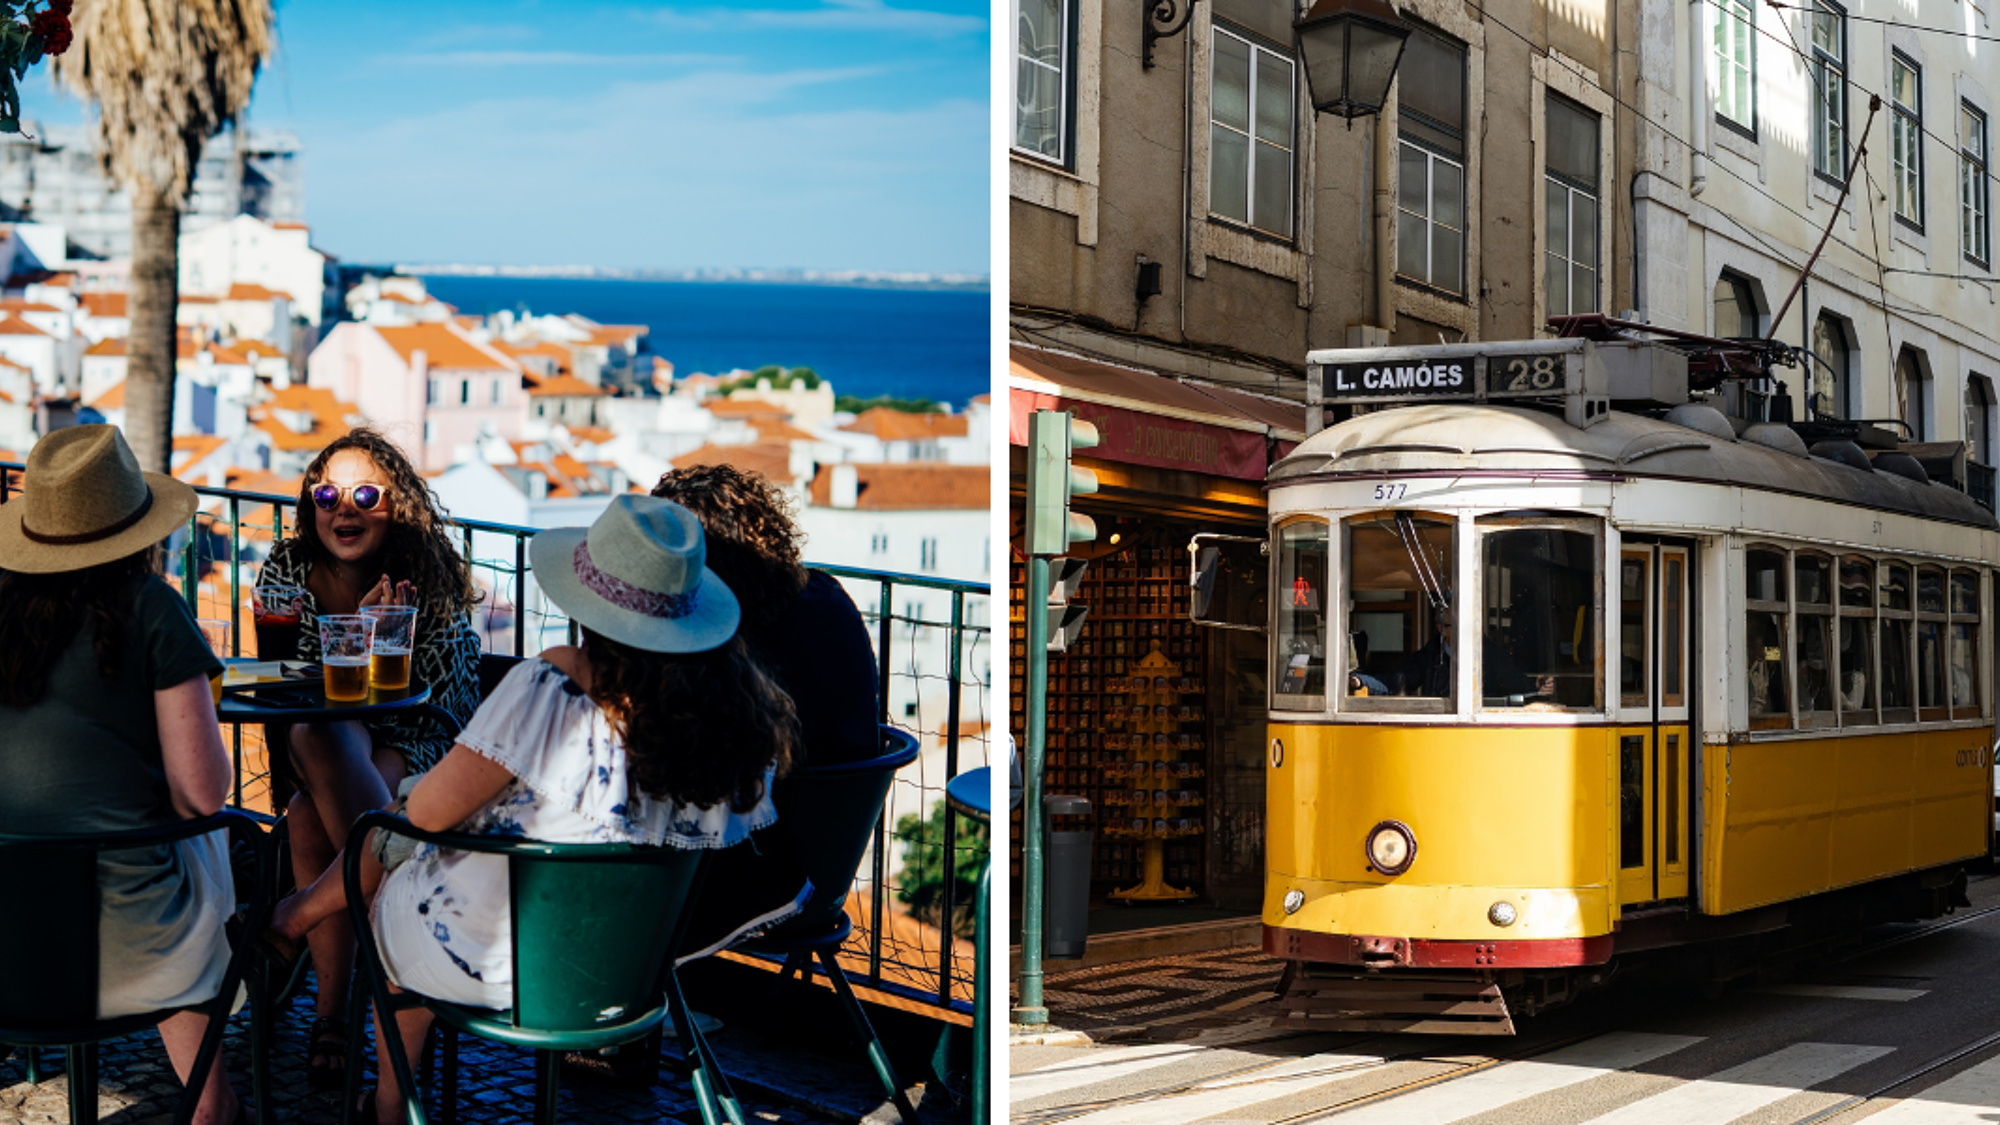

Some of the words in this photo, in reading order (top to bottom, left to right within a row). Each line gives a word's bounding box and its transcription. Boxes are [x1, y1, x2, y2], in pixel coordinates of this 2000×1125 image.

[1336, 369, 1356, 391] L.
[1507, 356, 1555, 391] 28
[1374, 483, 1408, 500] 577
